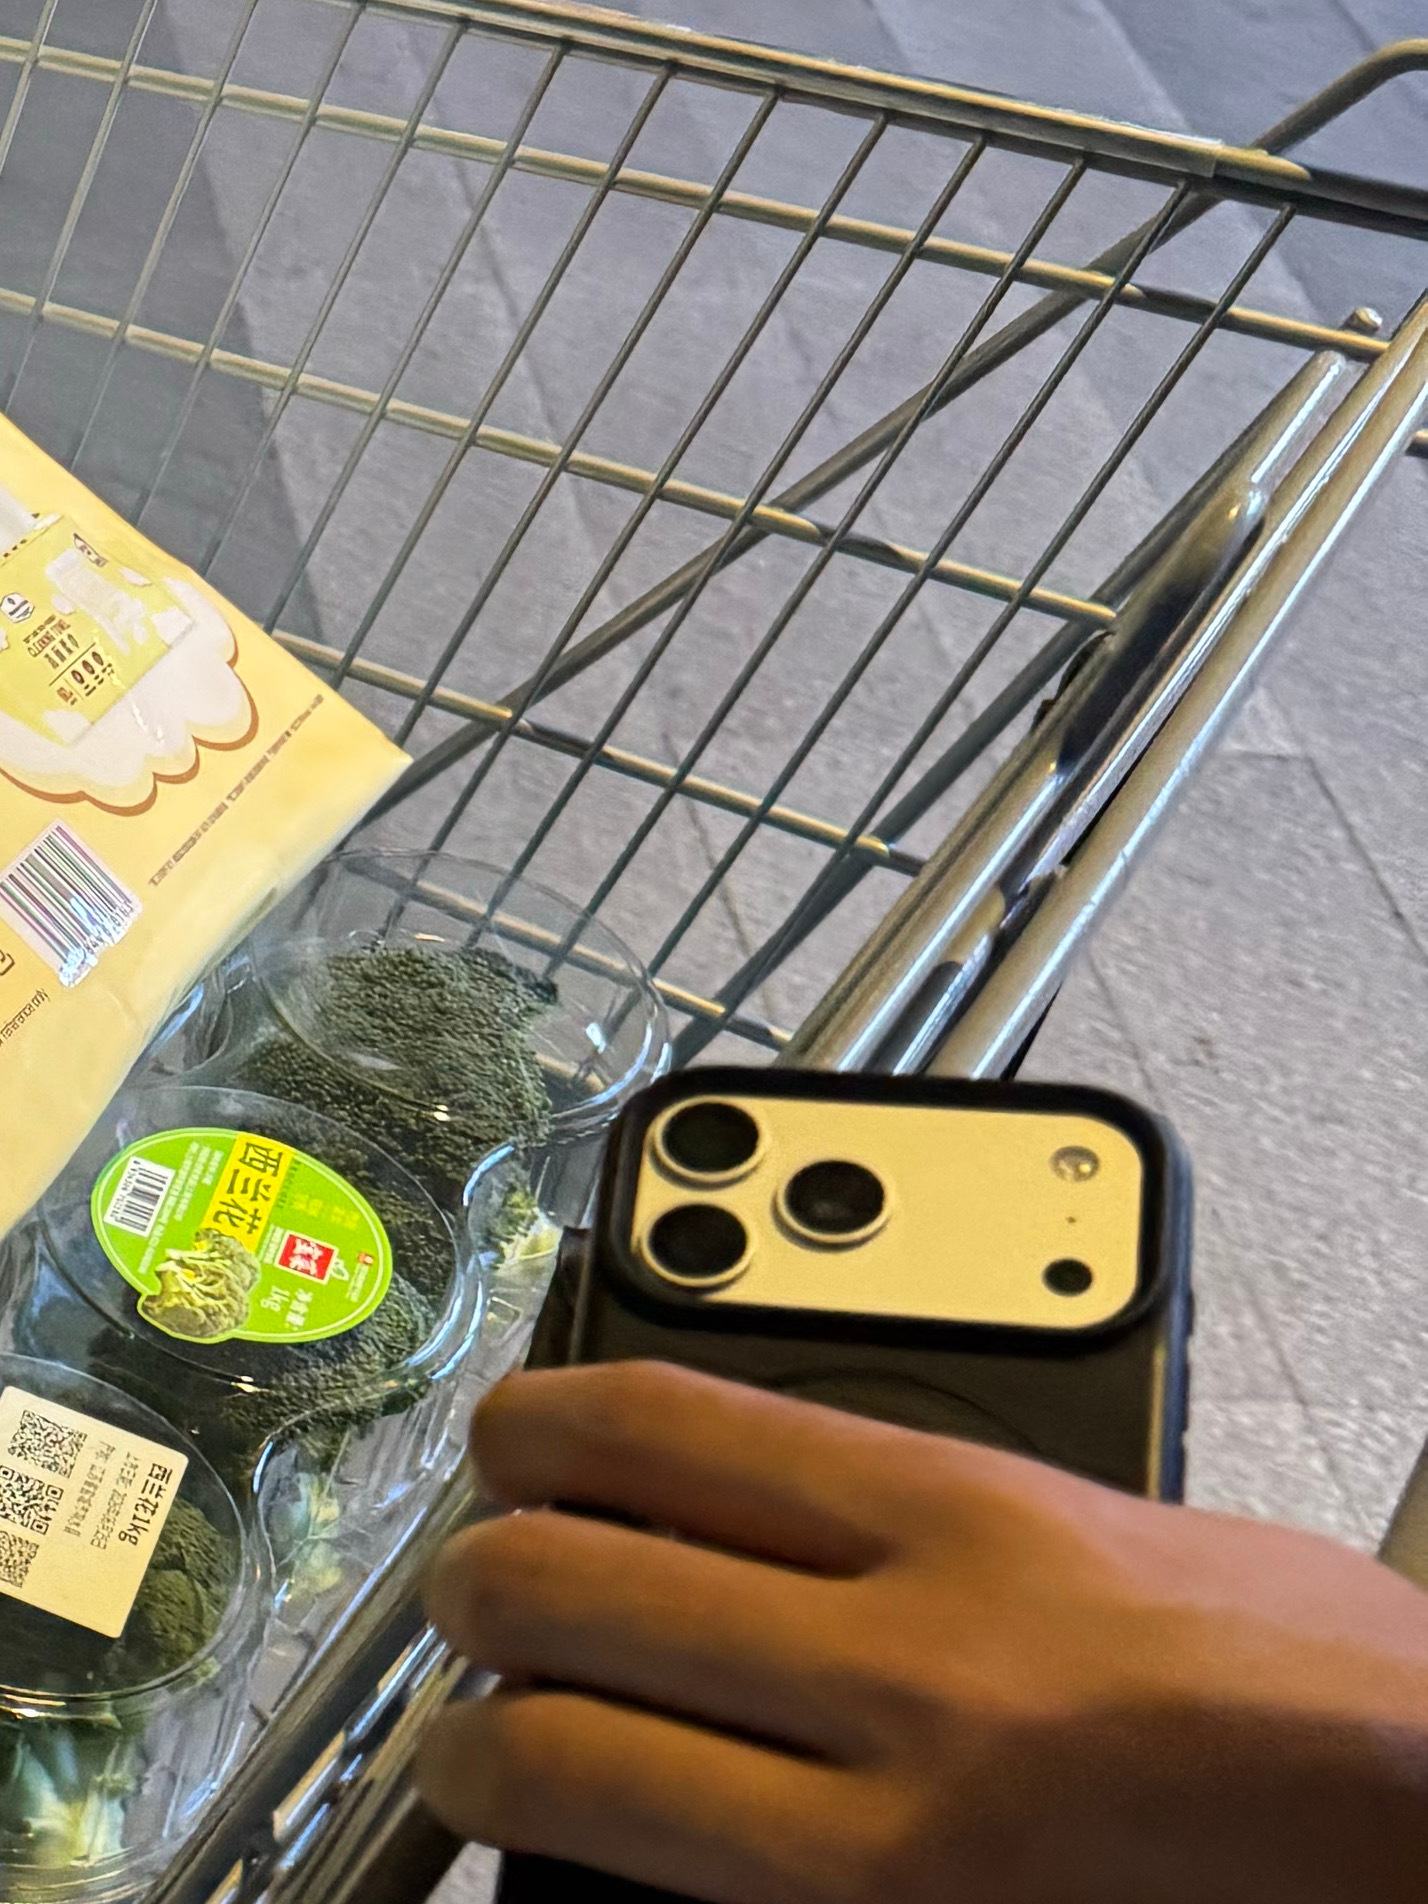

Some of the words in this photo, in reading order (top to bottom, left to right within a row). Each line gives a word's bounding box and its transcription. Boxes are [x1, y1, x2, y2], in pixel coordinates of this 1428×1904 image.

[212, 1141, 284, 1235] 西兰花
[260, 1284, 291, 1313] 1kg
[118, 1463, 172, 1545] 西兰花1kg
